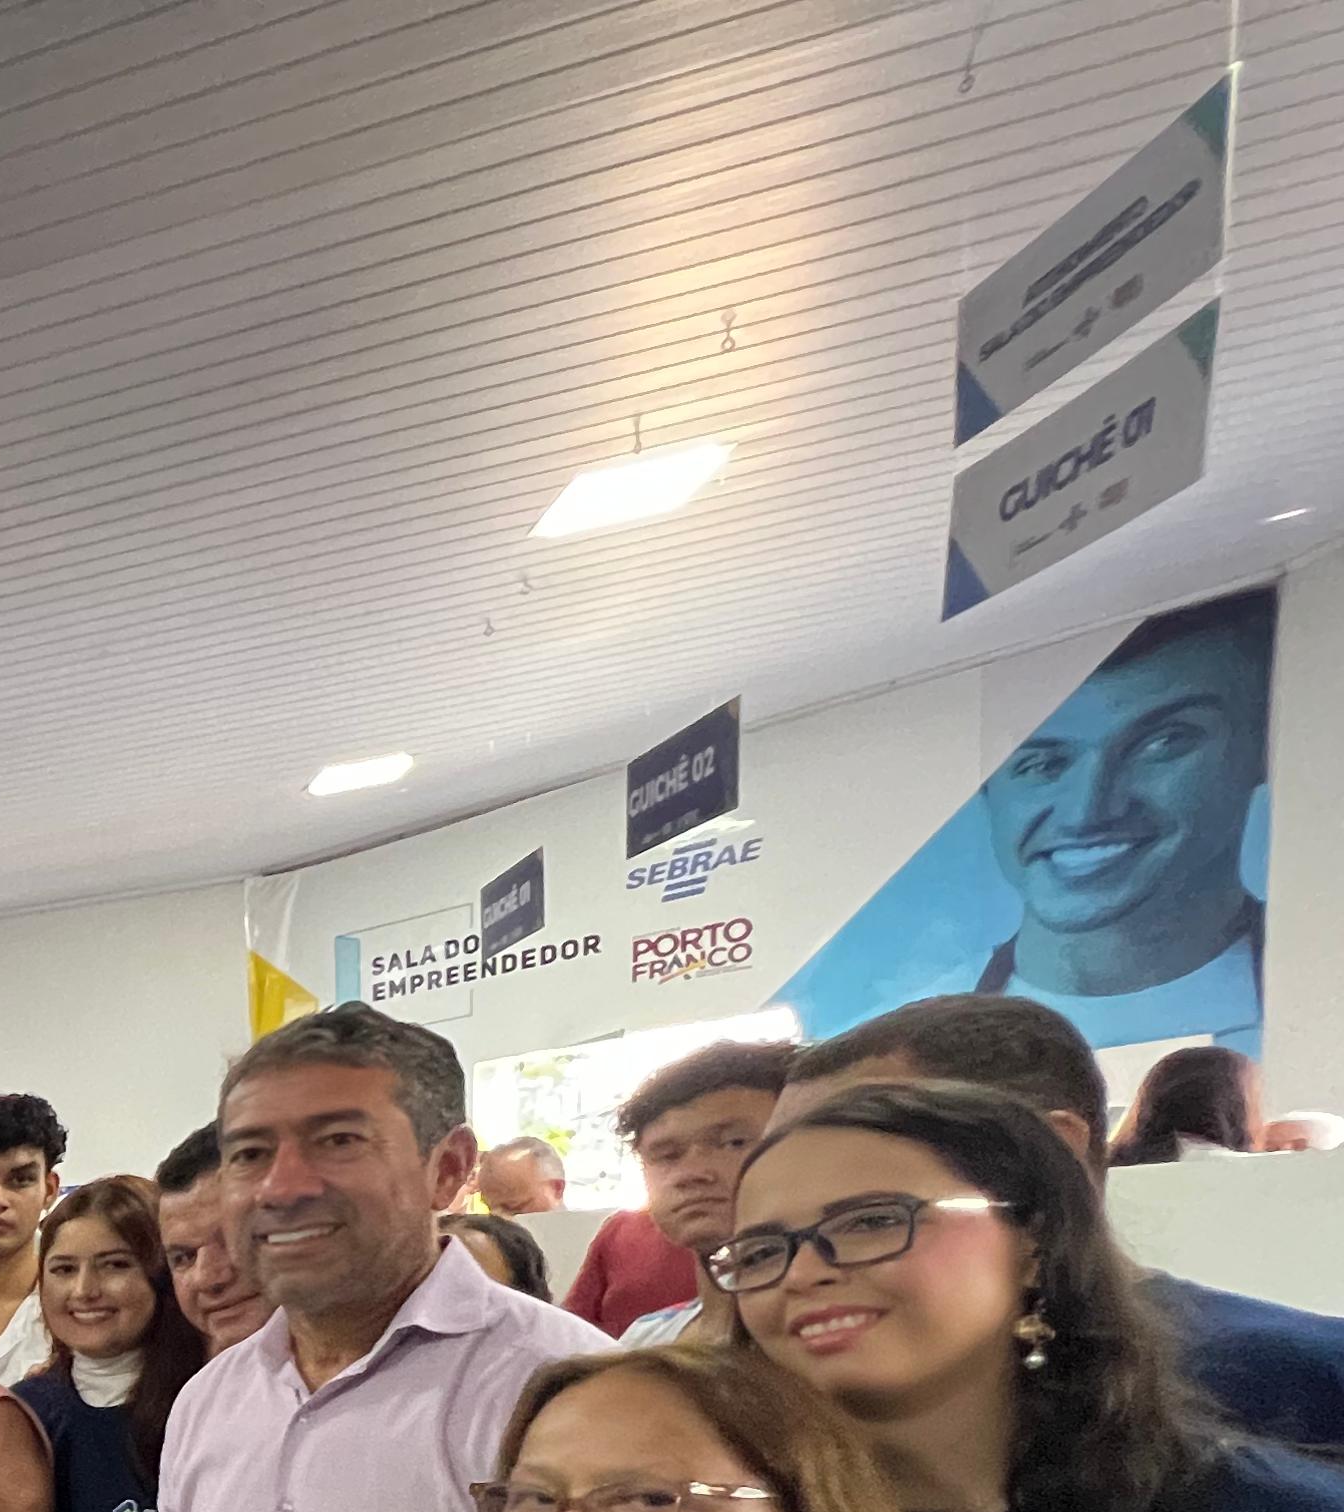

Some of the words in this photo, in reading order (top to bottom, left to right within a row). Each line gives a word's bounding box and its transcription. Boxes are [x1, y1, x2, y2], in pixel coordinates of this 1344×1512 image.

[629, 753, 689, 818] GUICHÊ
[692, 745, 715, 783] 02
[626, 838, 765, 890] SEBRAE
[371, 944, 436, 976] SALA
[445, 934, 480, 960] DO
[632, 918, 753, 963] PORTO
[632, 943, 752, 983] FRANCO
[372, 934, 603, 1002] EMPREENDEDOR
